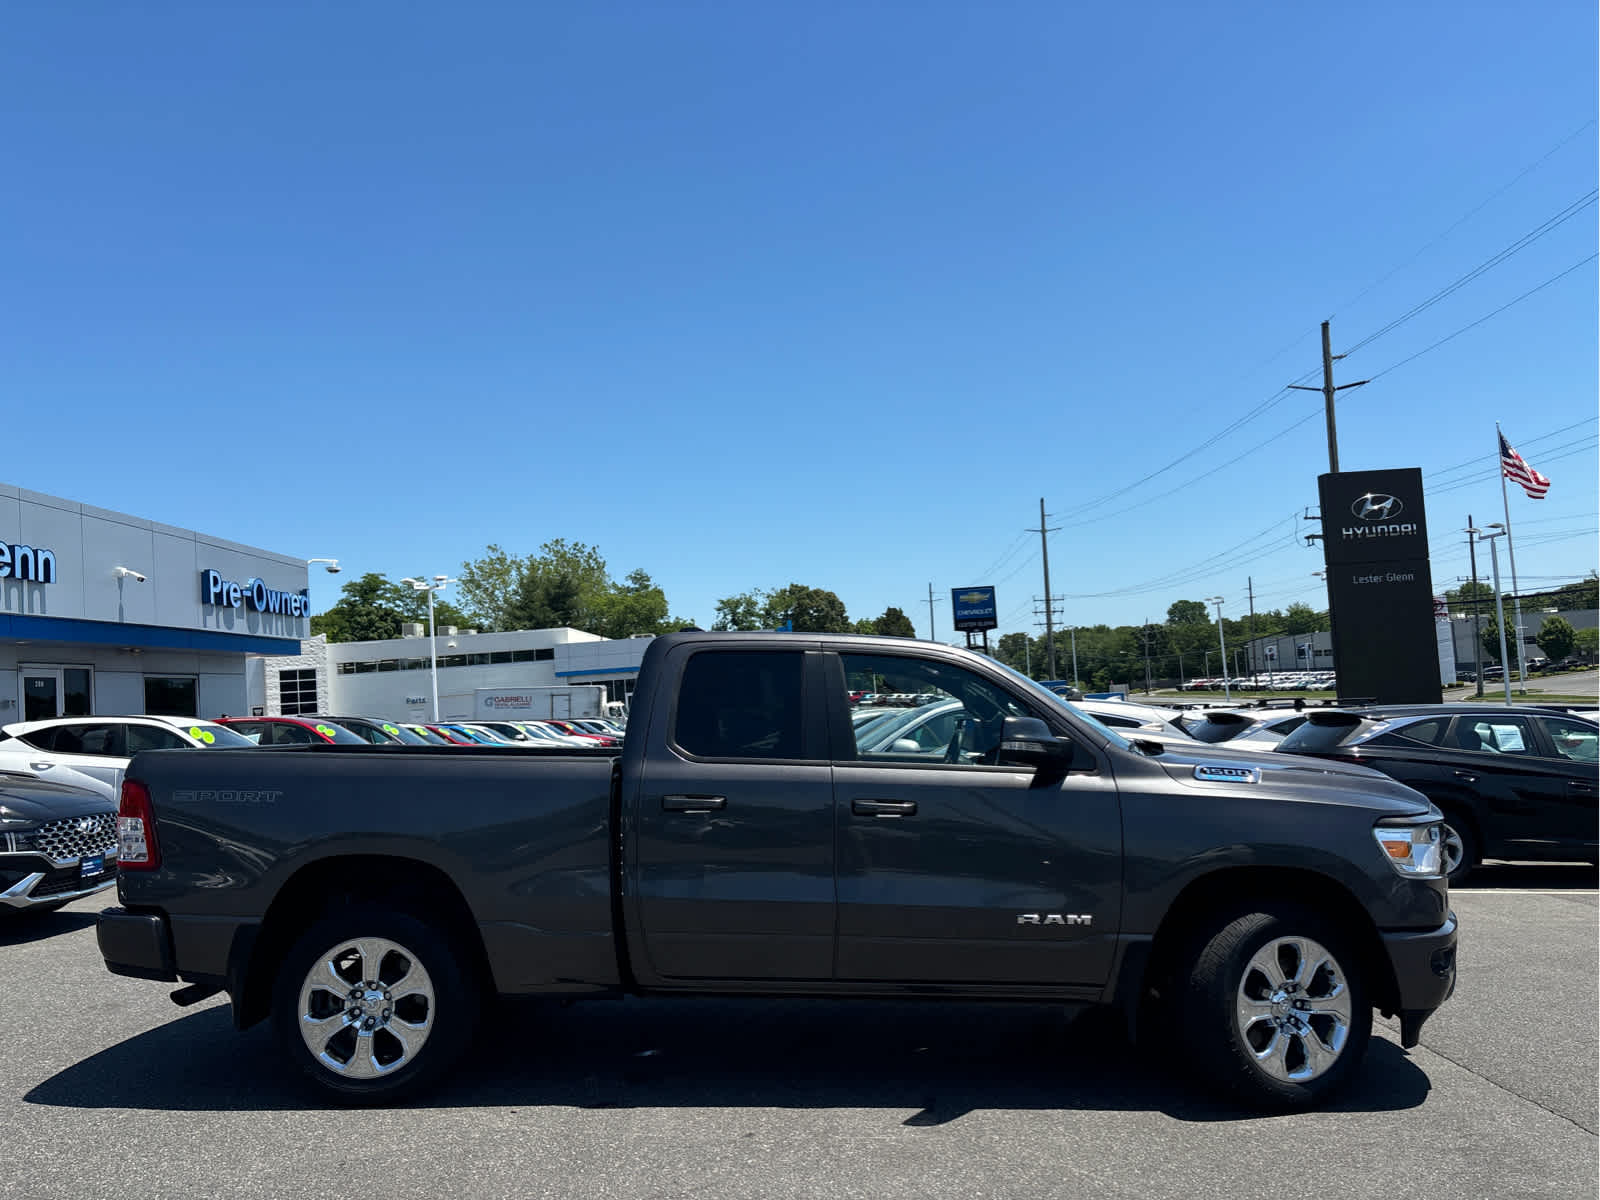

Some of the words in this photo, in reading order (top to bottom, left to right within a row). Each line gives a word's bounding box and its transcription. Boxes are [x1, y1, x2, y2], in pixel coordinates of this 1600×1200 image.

[1342, 523, 1417, 539] HYUNDAI
[1352, 574, 1383, 585] Lester
[1386, 572, 1415, 583] Glenn
[203, 569, 310, 618] Pre-Owned
[957, 608, 993, 616] CHEVROLET
[172, 790, 283, 802] SPORT
[1016, 914, 1093, 926] RAM
